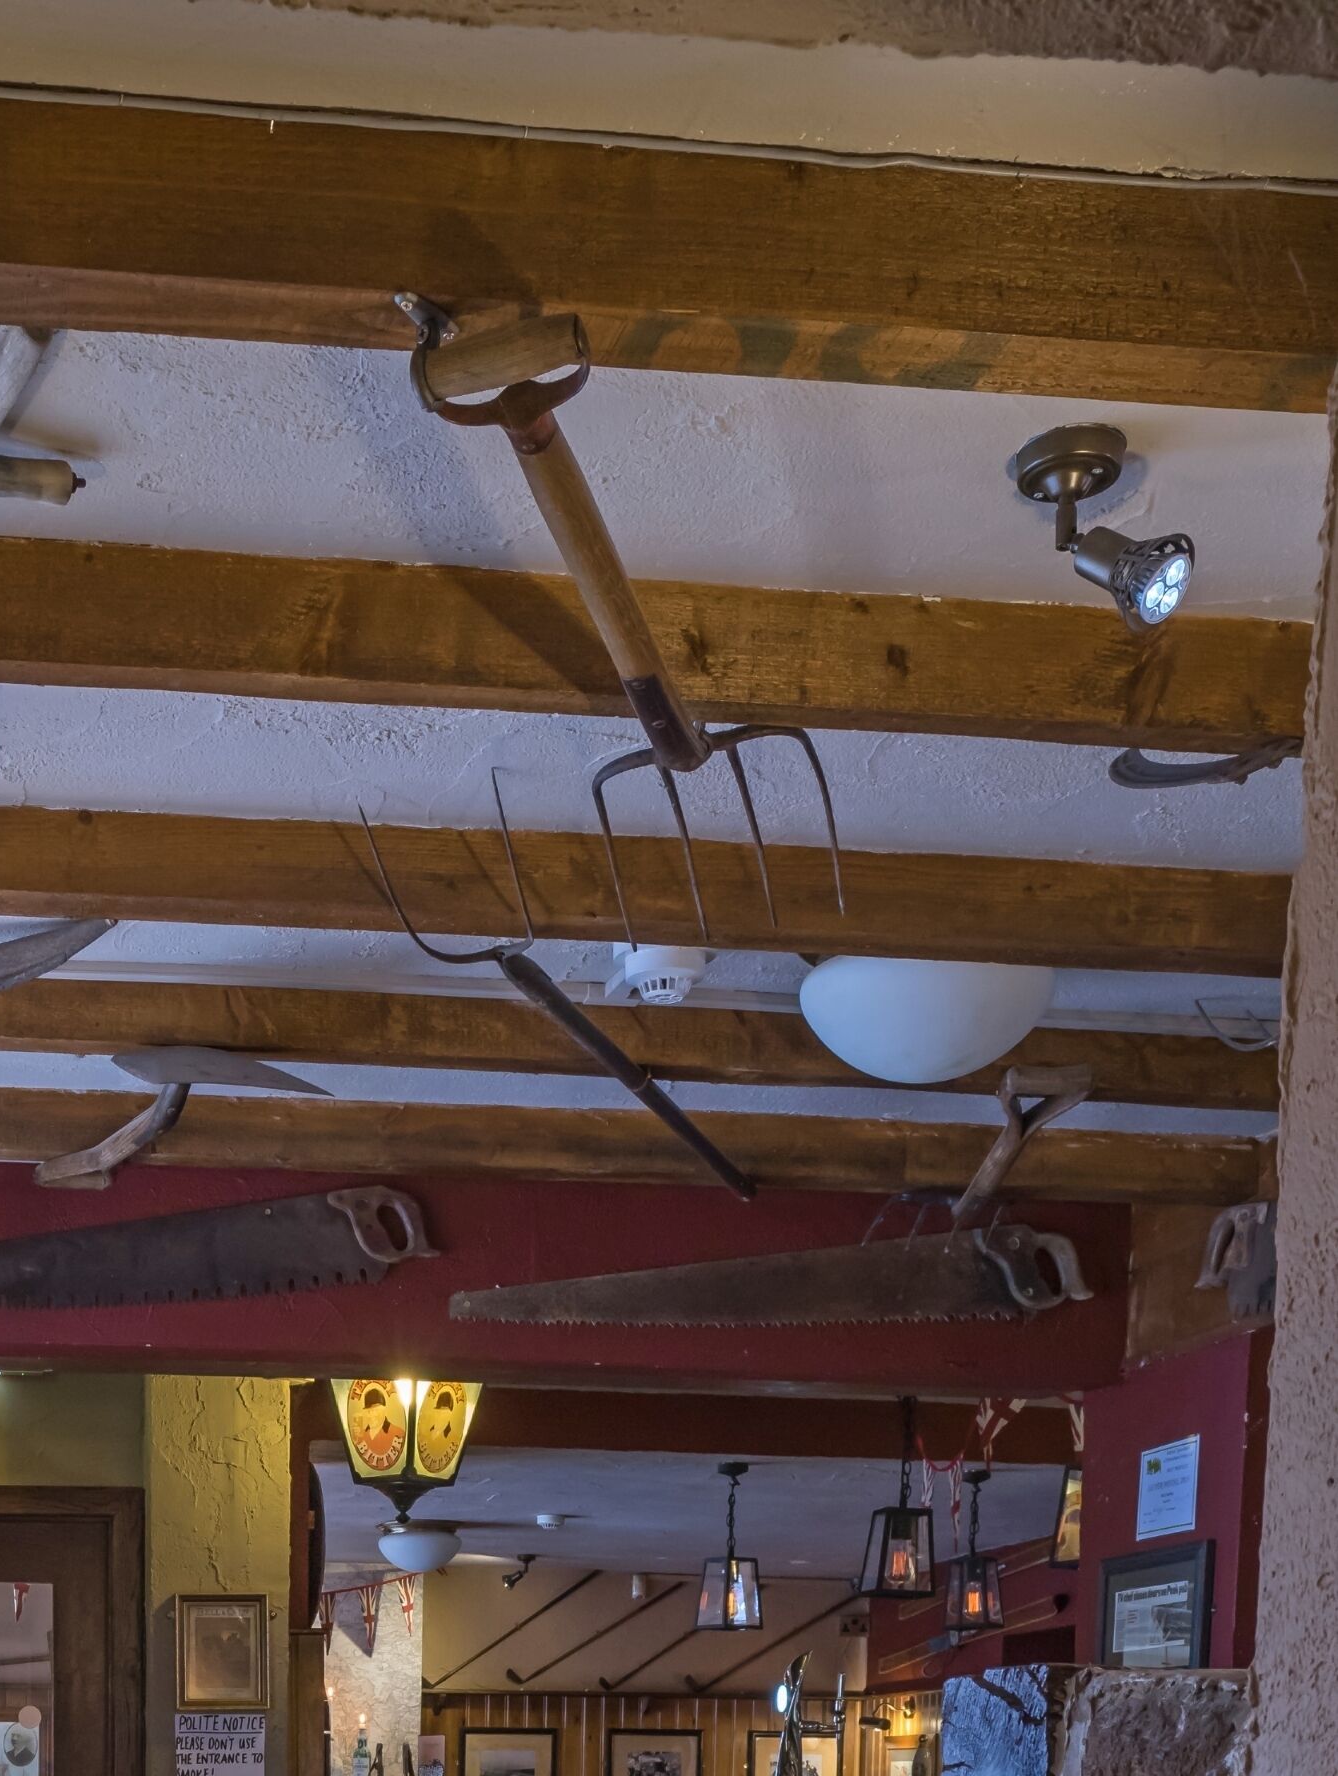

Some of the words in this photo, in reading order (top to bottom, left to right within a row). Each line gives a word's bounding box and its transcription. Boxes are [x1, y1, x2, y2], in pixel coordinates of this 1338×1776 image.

[357, 1435, 403, 1467] BITTER
[420, 1442, 459, 1470] BITTER
[179, 1715, 219, 1731] POLITE
[222, 1716, 265, 1731] NOTICE
[176, 1736, 205, 1750] PLEASE
[239, 1736, 256, 1749] USE
[176, 1753, 192, 1765] THE
[196, 1752, 248, 1765] ENTRANCE
[252, 1753, 263, 1763] TO
